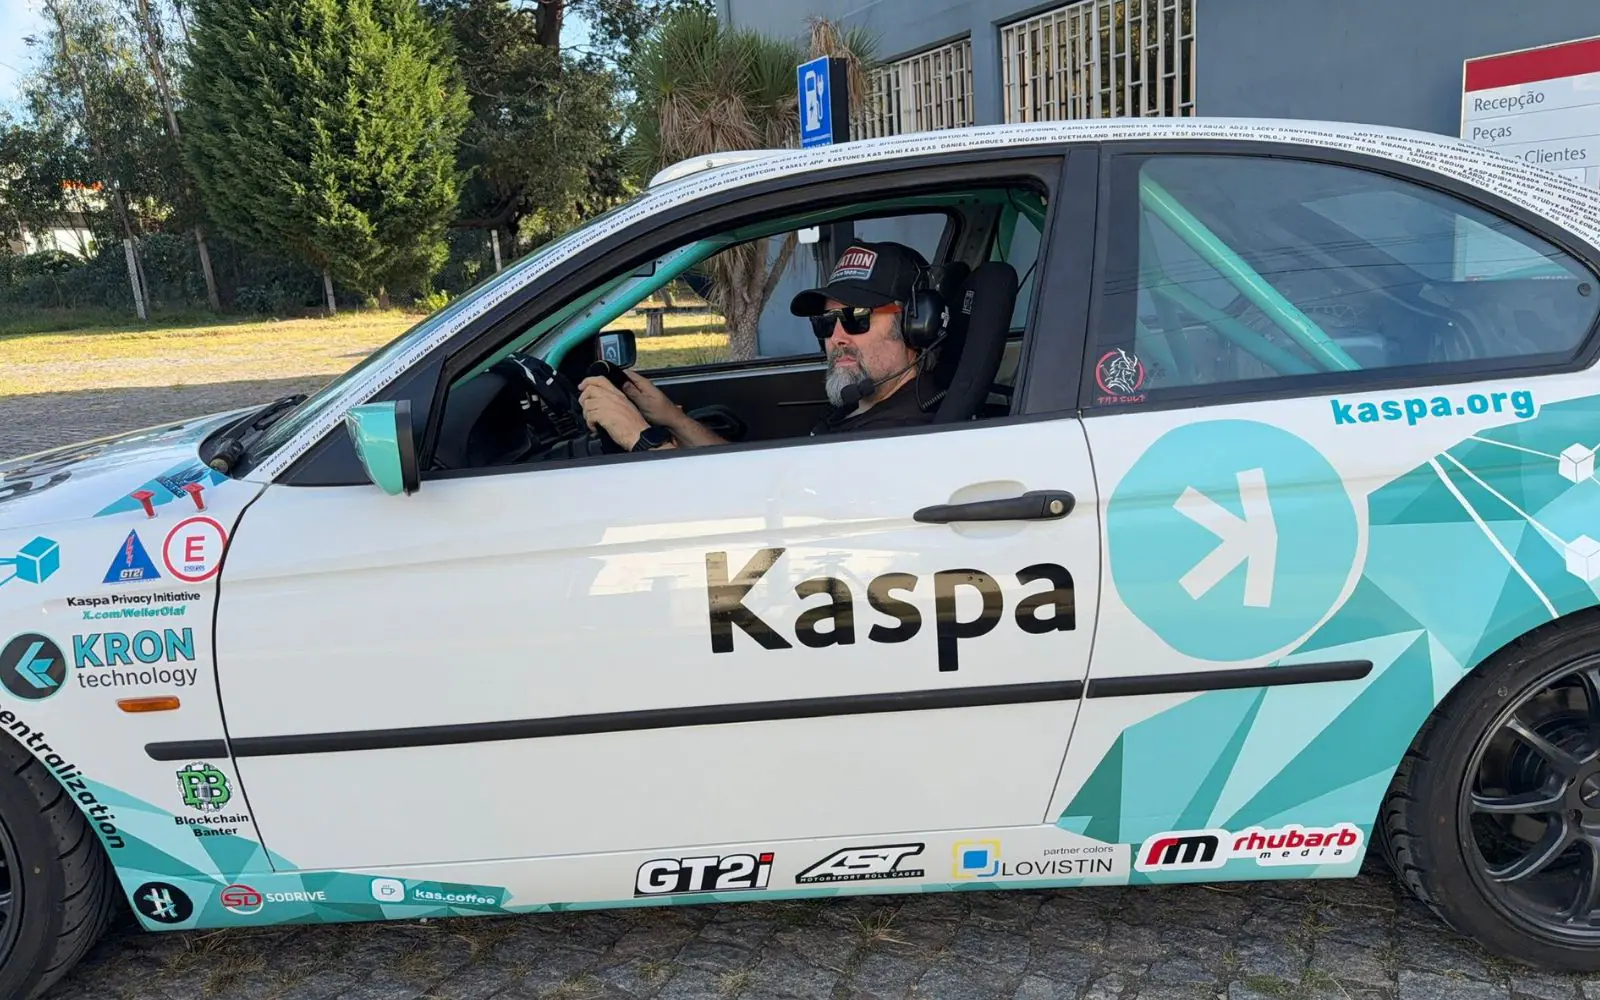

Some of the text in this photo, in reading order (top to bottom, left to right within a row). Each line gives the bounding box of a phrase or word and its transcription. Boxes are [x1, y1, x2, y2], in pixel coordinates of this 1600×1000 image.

[1474, 91, 1545, 112] Recepção
[1473, 126, 1512, 141] Peças
[1525, 147, 1587, 164] Clientes
[1543, 181, 1588, 198] CONNECTION
[270, 459, 288, 475] HASH
[940, 140, 966, 149] DANIEL
[968, 137, 1003, 145] MARQUES
[1330, 388, 1536, 426] kaspa.org
[185, 535, 206, 562] E
[67, 591, 200, 608] Kaspa Privacy Initiative
[705, 547, 1077, 672] Kaspa
[72, 627, 196, 669] KRON
[77, 666, 198, 690] technology
[0, 703, 126, 850] entralization
[174, 813, 249, 826] Blockchain
[193, 826, 238, 837] Banter
[1233, 828, 1358, 852] rhubarb
[1043, 844, 1115, 857] partner colors
[1259, 847, 1343, 859] media
[634, 852, 775, 898] GT2i
[799, 870, 922, 883] MOTORSPORT ROLL CAGES
[1001, 857, 1114, 877] LOVISTIN
[265, 891, 327, 903] SODRIVE
[414, 888, 496, 906] kas.coffee
